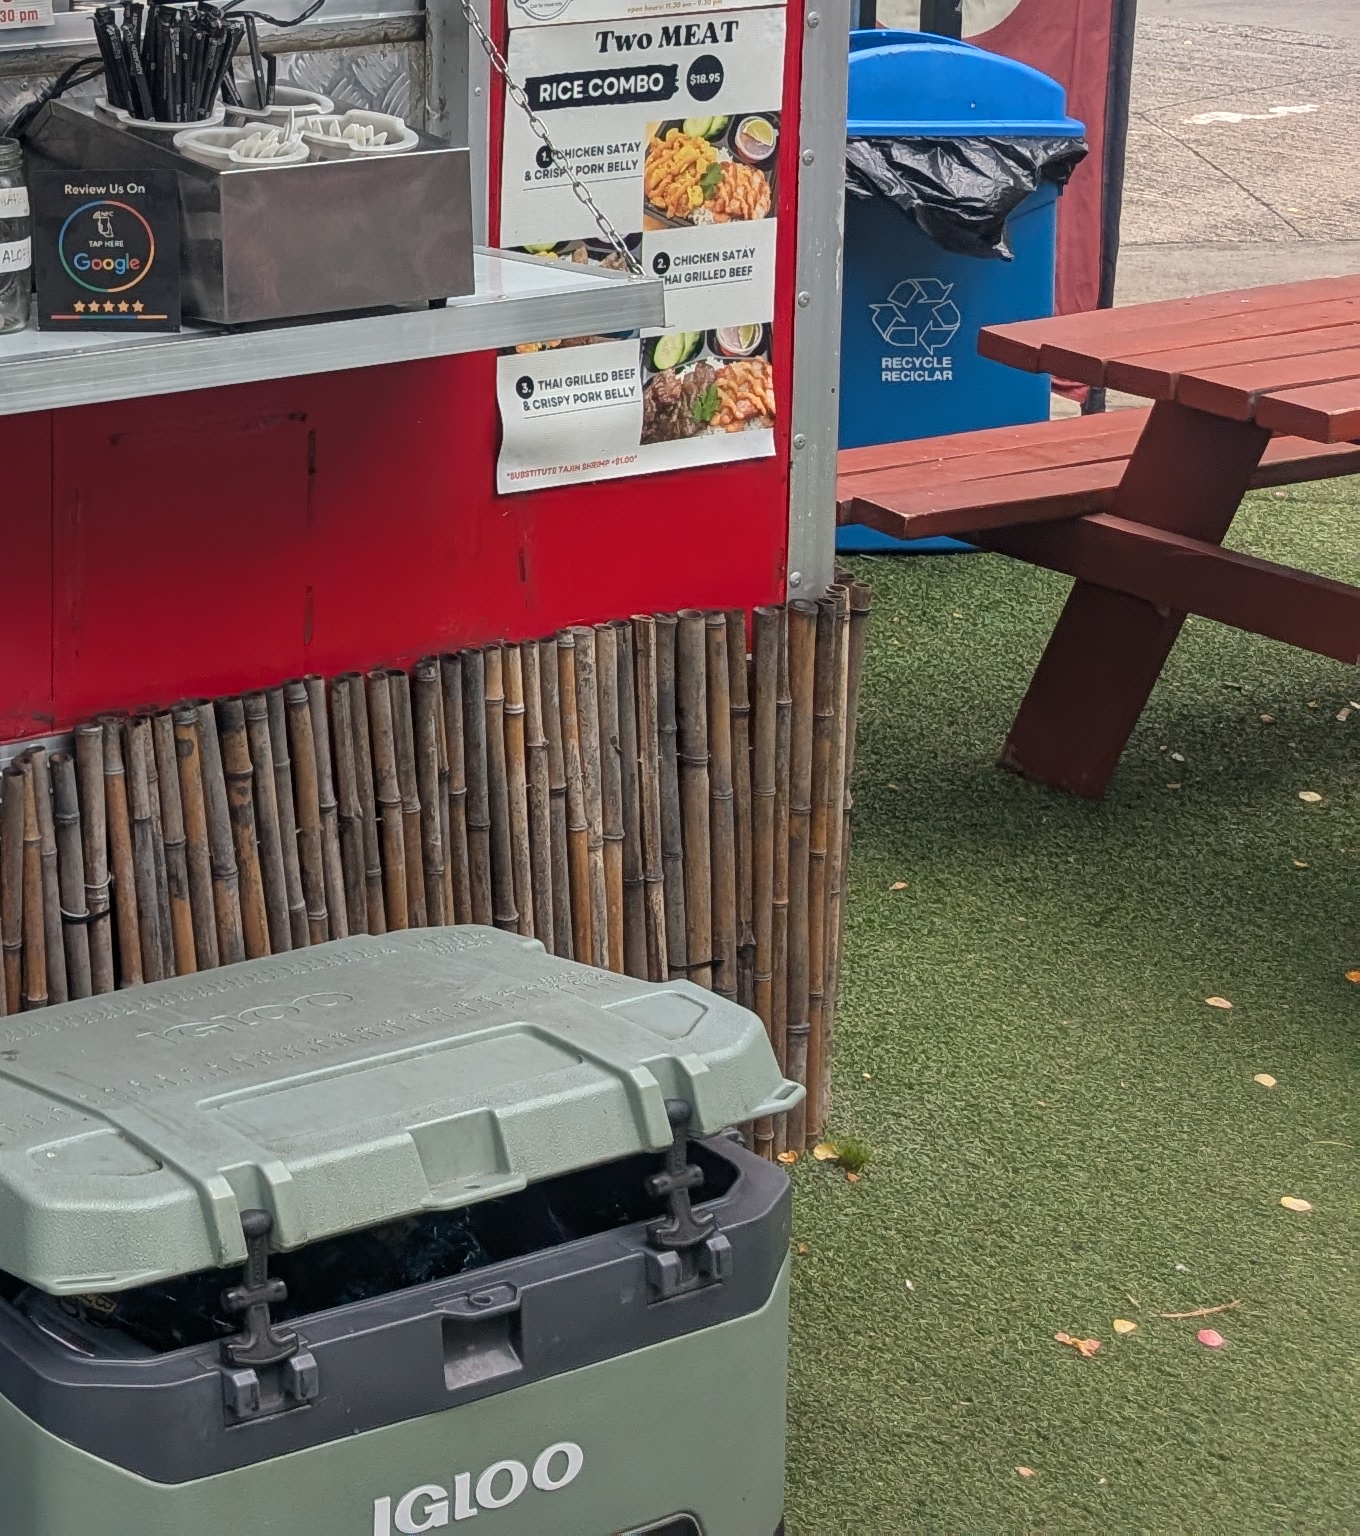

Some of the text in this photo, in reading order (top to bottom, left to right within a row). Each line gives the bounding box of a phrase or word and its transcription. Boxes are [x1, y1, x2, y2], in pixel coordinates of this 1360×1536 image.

[19, 10, 38, 23] pm
[596, 20, 739, 53] Two MEAT
[539, 73, 663, 102] RICE COMBO
[690, 73, 720, 85] $18.95
[65, 183, 145, 194] Review Us On
[74, 253, 140, 275] Google
[882, 356, 952, 368] RECYCLE
[538, 368, 635, 390] THAI GRILLED BEEF
[882, 370, 952, 382] RECICLAR
[523, 386, 635, 410] & CRISPY PORK BELLY
[374, 1442, 583, 1536] IGLOO
